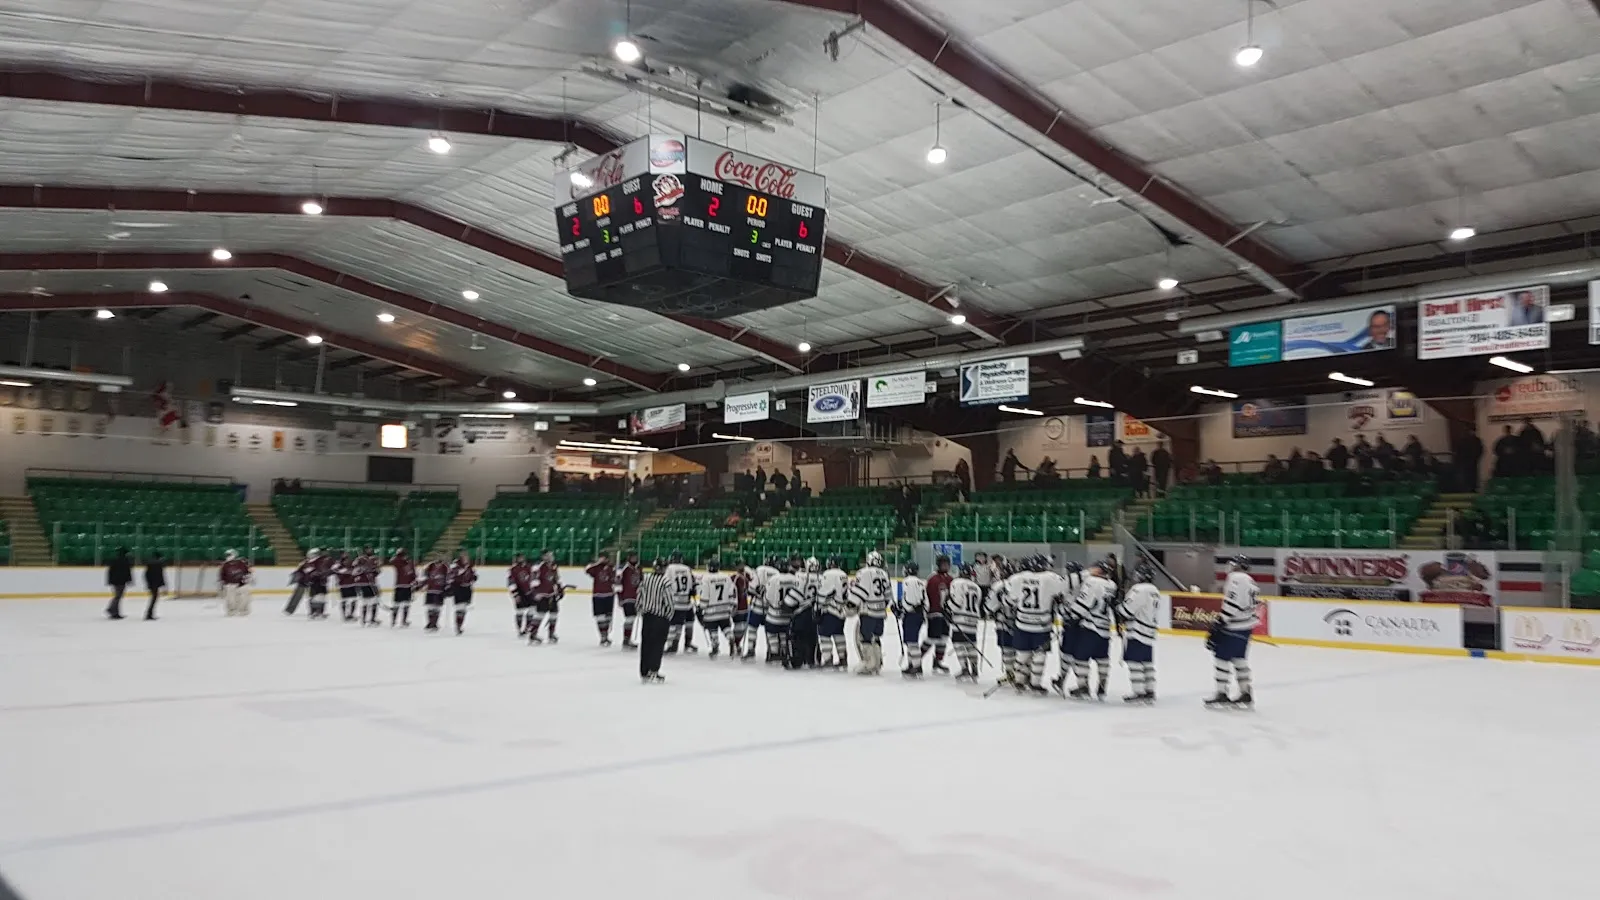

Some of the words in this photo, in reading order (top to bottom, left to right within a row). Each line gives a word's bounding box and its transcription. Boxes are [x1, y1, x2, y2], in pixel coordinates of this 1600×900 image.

[701, 179, 723, 195] HOME
[708, 197, 719, 217] 2
[791, 203, 813, 218] GUEST
[684, 215, 704, 229] PLAYER
[708, 222, 731, 234] PENALTY
[747, 216, 765, 229] PERIOD
[750, 229, 759, 244] 3
[774, 237, 793, 249] PLAYER
[796, 242, 816, 254] PENALTY
[733, 247, 750, 259] SHOTS
[756, 252, 772, 263] SHOTS
[810, 383, 850, 402] STEELTOWN
[726, 401, 758, 415] Progressive
[820, 398, 840, 411] Ford
[675, 576, 688, 592] 19
[715, 584, 725, 601] 7
[1022, 587, 1040, 609] 21
[1364, 615, 1441, 632] CANALTA
